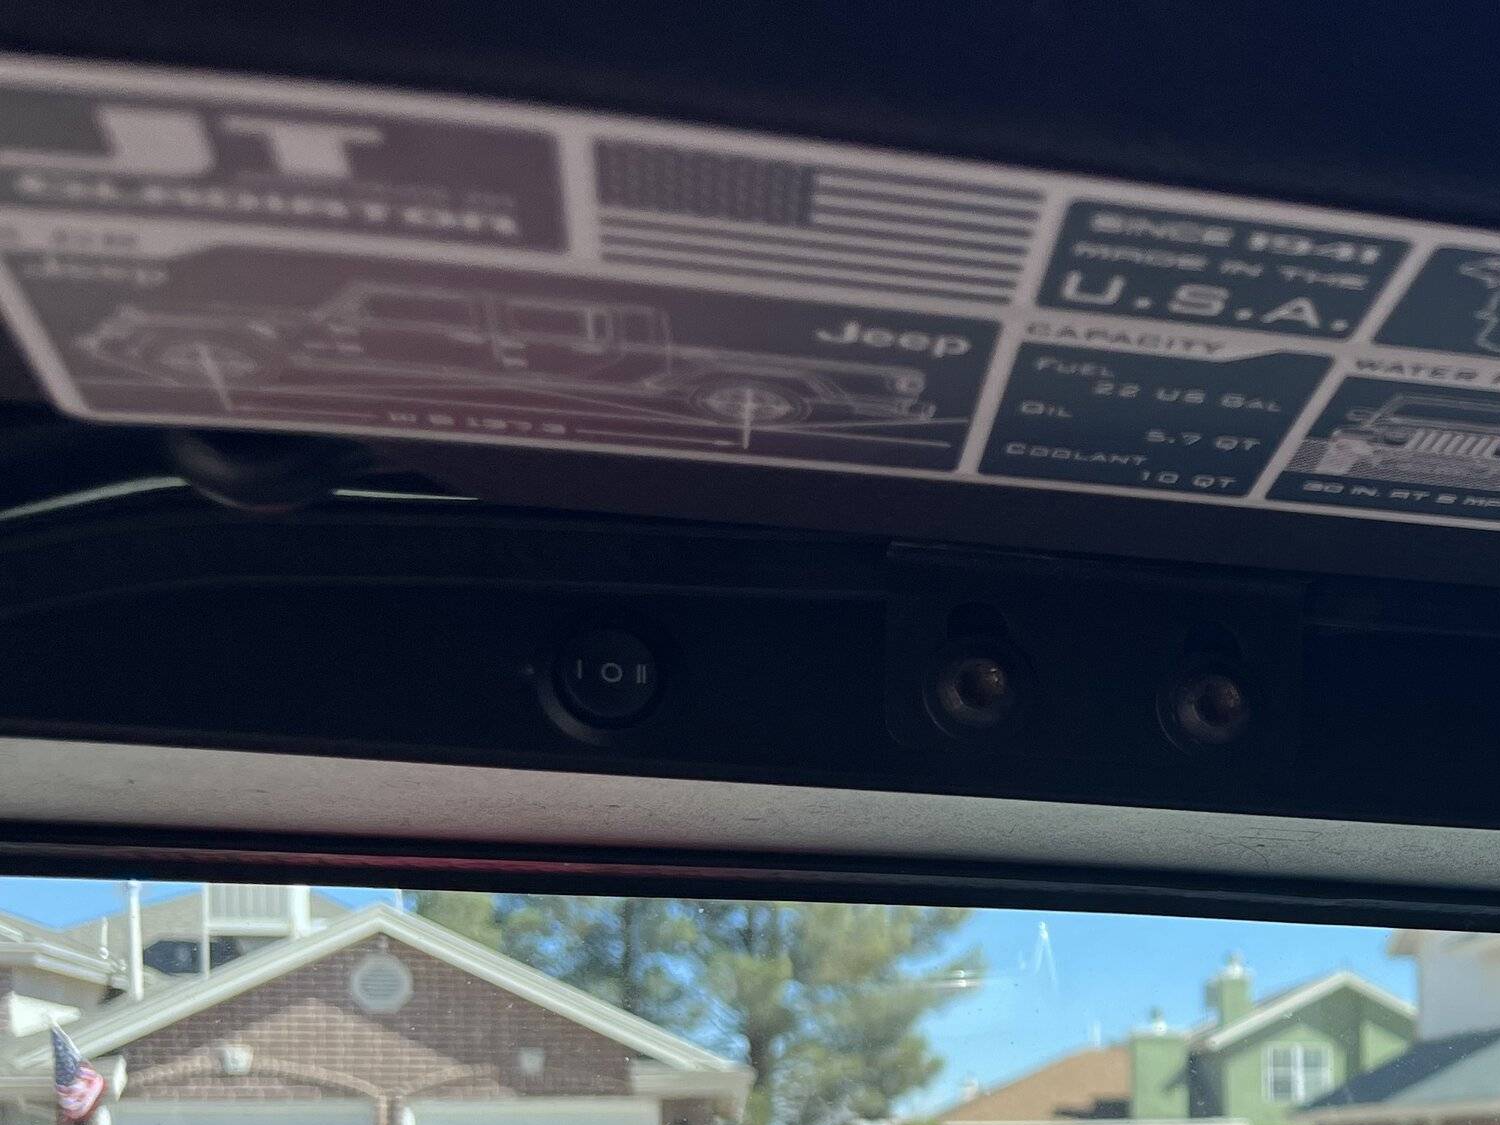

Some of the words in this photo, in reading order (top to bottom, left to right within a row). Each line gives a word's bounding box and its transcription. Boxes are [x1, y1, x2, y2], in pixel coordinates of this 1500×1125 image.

[1248, 231, 1382, 266] 1941
[1060, 268, 1349, 333] U.S.A.
[815, 319, 972, 359] Jeep
[1025, 320, 1226, 353] CAPACITY
[1034, 355, 1114, 378] FUEL
[1354, 357, 1480, 387] WATER
[1020, 400, 1075, 419] OIL
[1094, 380, 1141, 398] 22
[1155, 387, 1207, 404] US
[1220, 392, 1282, 413] GAL
[1004, 440, 1148, 467] COOLANT
[1213, 433, 1264, 452] QT
[1139, 467, 1181, 485] 10
[1191, 473, 1239, 490] QT
